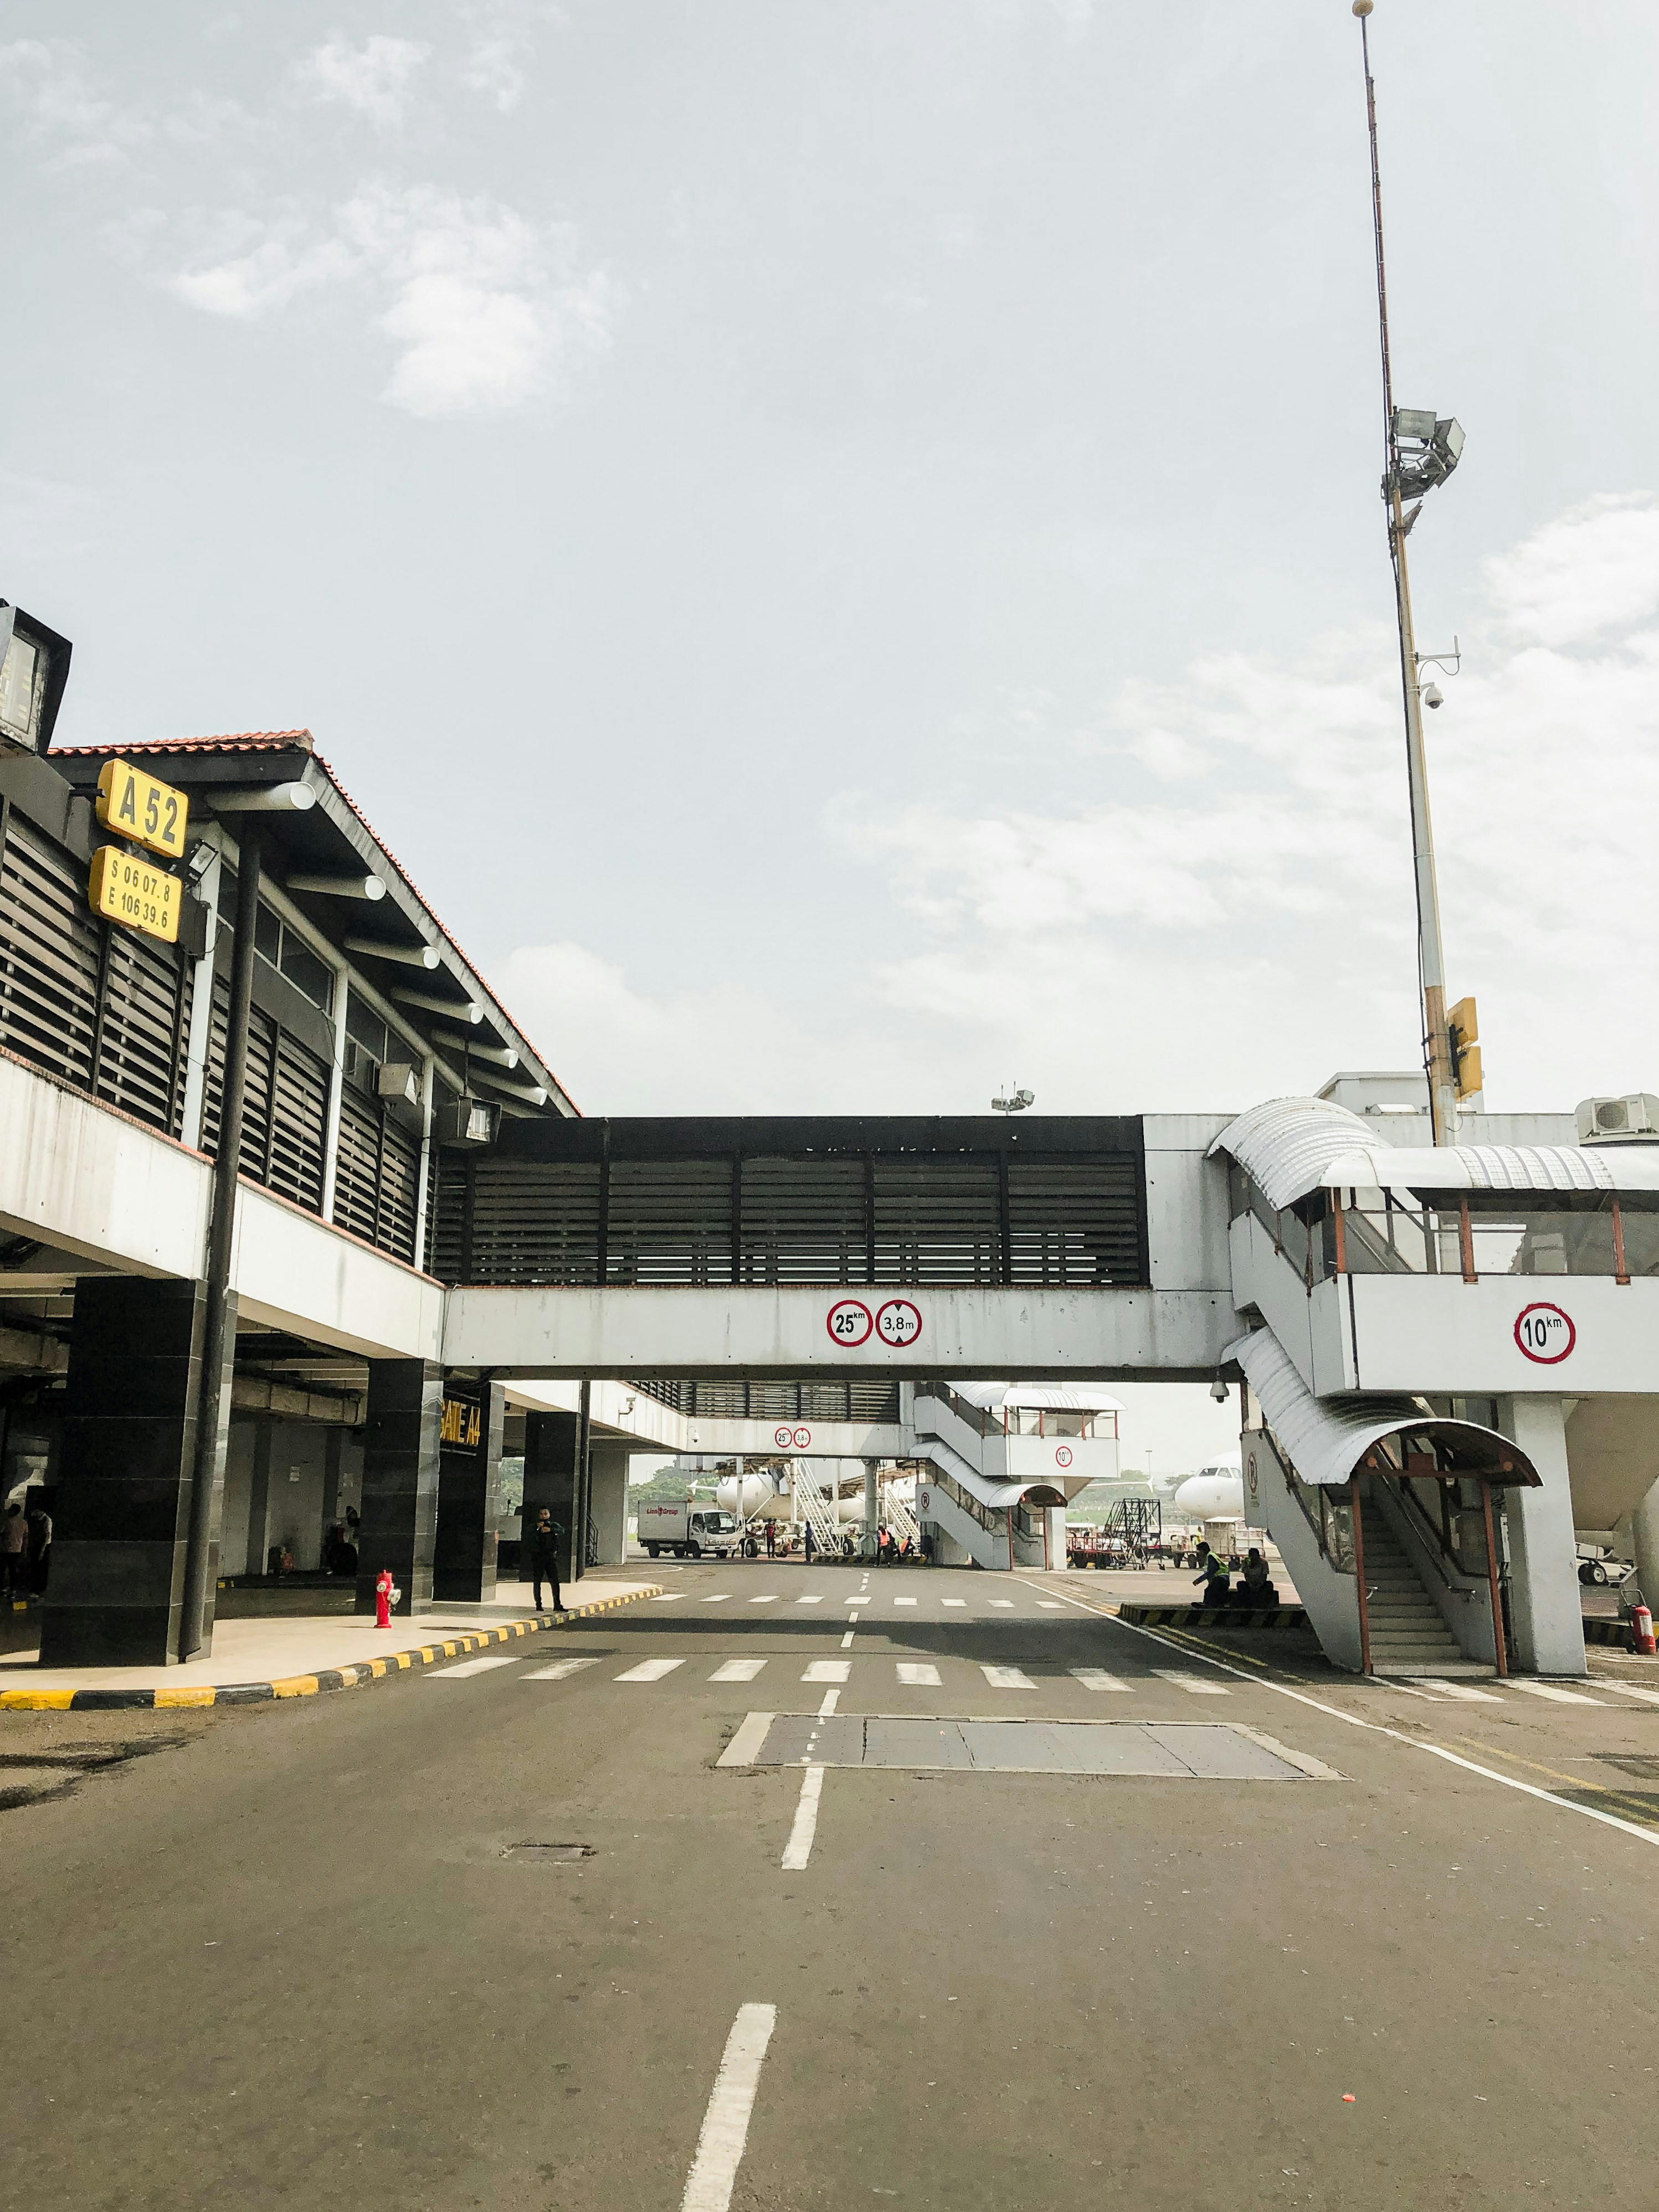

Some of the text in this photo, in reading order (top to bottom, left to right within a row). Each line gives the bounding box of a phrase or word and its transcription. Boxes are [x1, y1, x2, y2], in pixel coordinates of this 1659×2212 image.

[119, 776, 177, 845] A 52
[111, 860, 118, 878] S
[124, 866, 139, 887] 06
[109, 886, 115, 905] E
[121, 892, 140, 915] 106
[466, 1406, 480, 1445] A4
